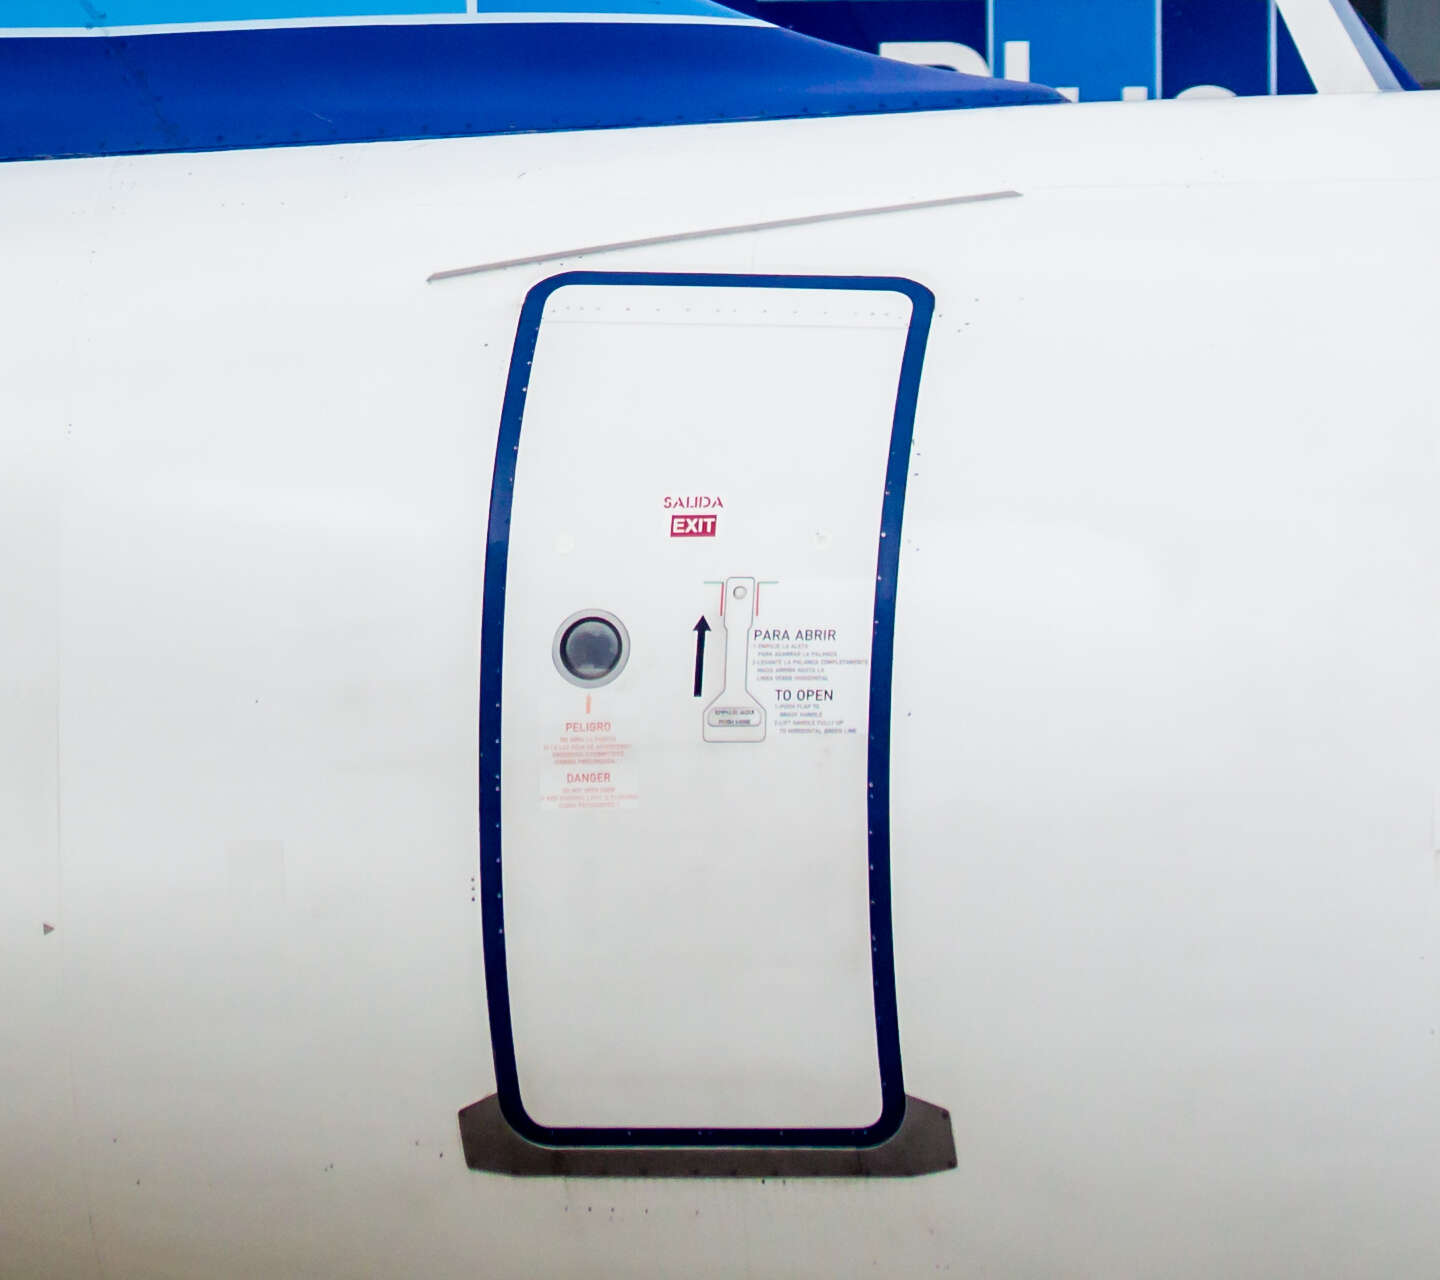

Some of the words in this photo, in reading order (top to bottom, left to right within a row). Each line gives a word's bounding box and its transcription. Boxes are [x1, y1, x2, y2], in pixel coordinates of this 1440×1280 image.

[663, 496, 724, 509] SALIDA
[672, 517, 716, 534] EXIT
[753, 628, 790, 641] PARA
[795, 628, 837, 641] ABRIR
[775, 689, 792, 701] TO
[796, 689, 834, 701] OPEN
[565, 721, 612, 732] PELIGRO
[566, 772, 611, 783] DANGER
